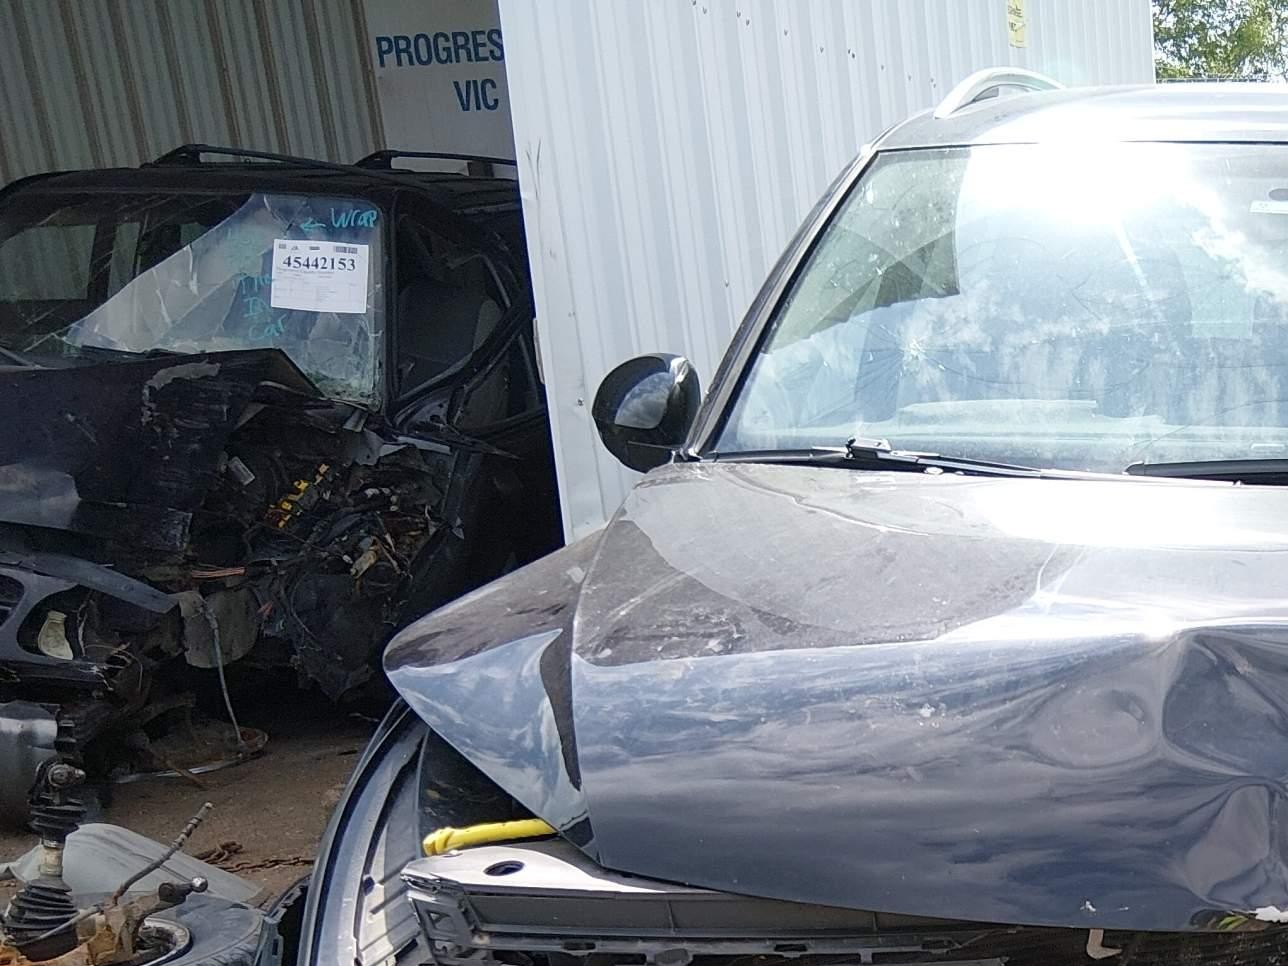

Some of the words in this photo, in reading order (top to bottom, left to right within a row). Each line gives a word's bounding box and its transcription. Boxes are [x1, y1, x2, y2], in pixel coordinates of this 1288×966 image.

[375, 29, 505, 67] PROGRES
[453, 78, 499, 111] VIC
[283, 255, 356, 271] 45442153
